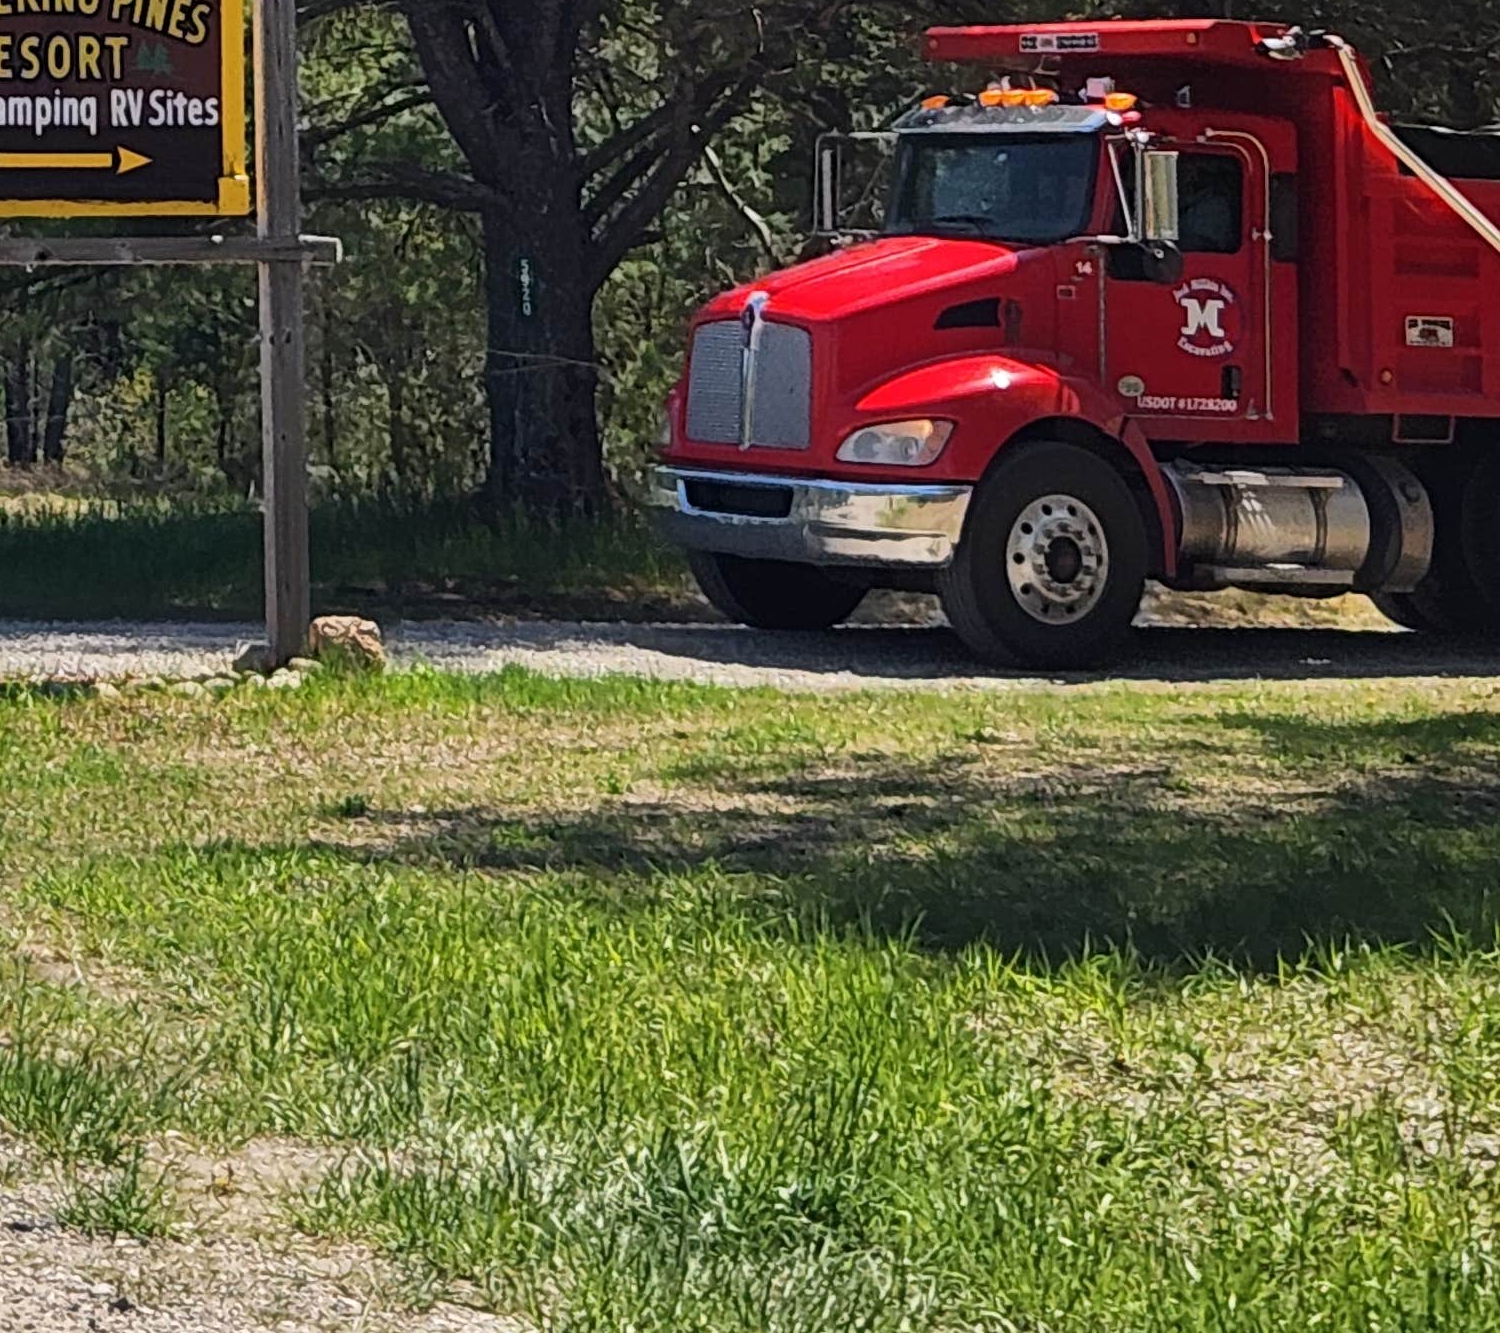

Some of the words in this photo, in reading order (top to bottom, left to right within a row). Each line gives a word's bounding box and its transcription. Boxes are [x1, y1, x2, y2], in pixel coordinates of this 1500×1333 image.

[110, 89, 145, 127] RV
[148, 89, 219, 127] Sites
[1137, 395, 1177, 410] USDOT
